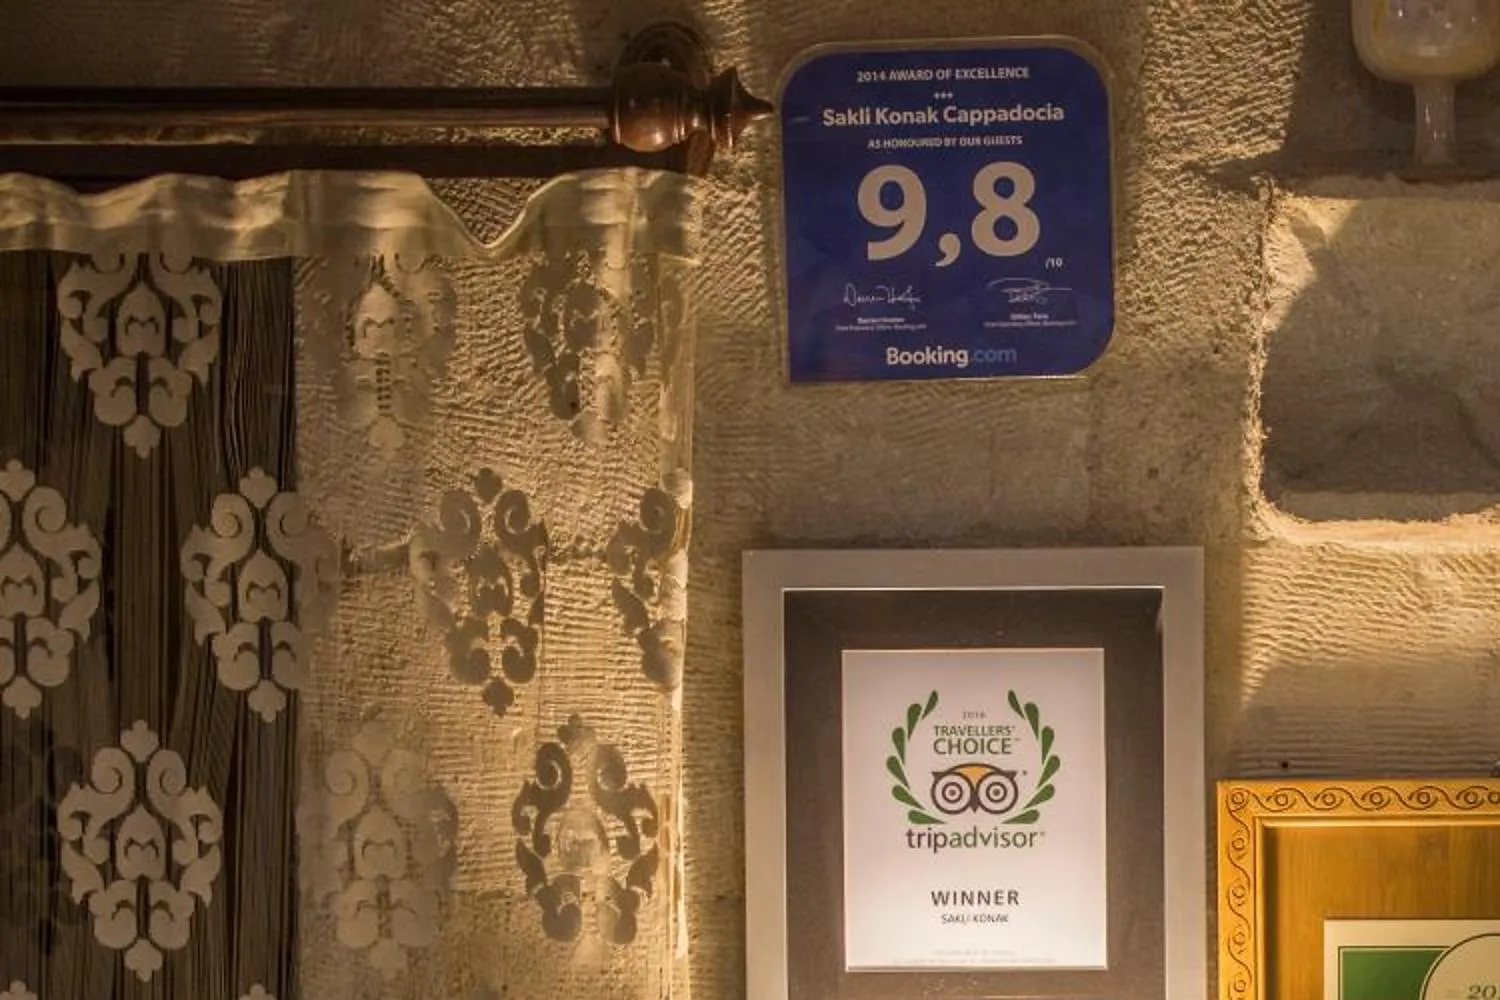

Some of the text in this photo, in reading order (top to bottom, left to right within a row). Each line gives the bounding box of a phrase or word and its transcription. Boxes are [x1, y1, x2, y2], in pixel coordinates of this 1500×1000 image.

[889, 69, 933, 82] AWARD
[936, 69, 950, 81] OF
[955, 67, 1030, 80] EXCELLENCE
[822, 103, 1065, 127] Sakli Konak Cappadocia
[857, 160, 1041, 267] 9,8
[886, 345, 1017, 368] Booking.com
[933, 738, 1012, 755] CHOICE
[905, 826, 1039, 853] tripadvisor
[931, 889, 1020, 907] WINNER
